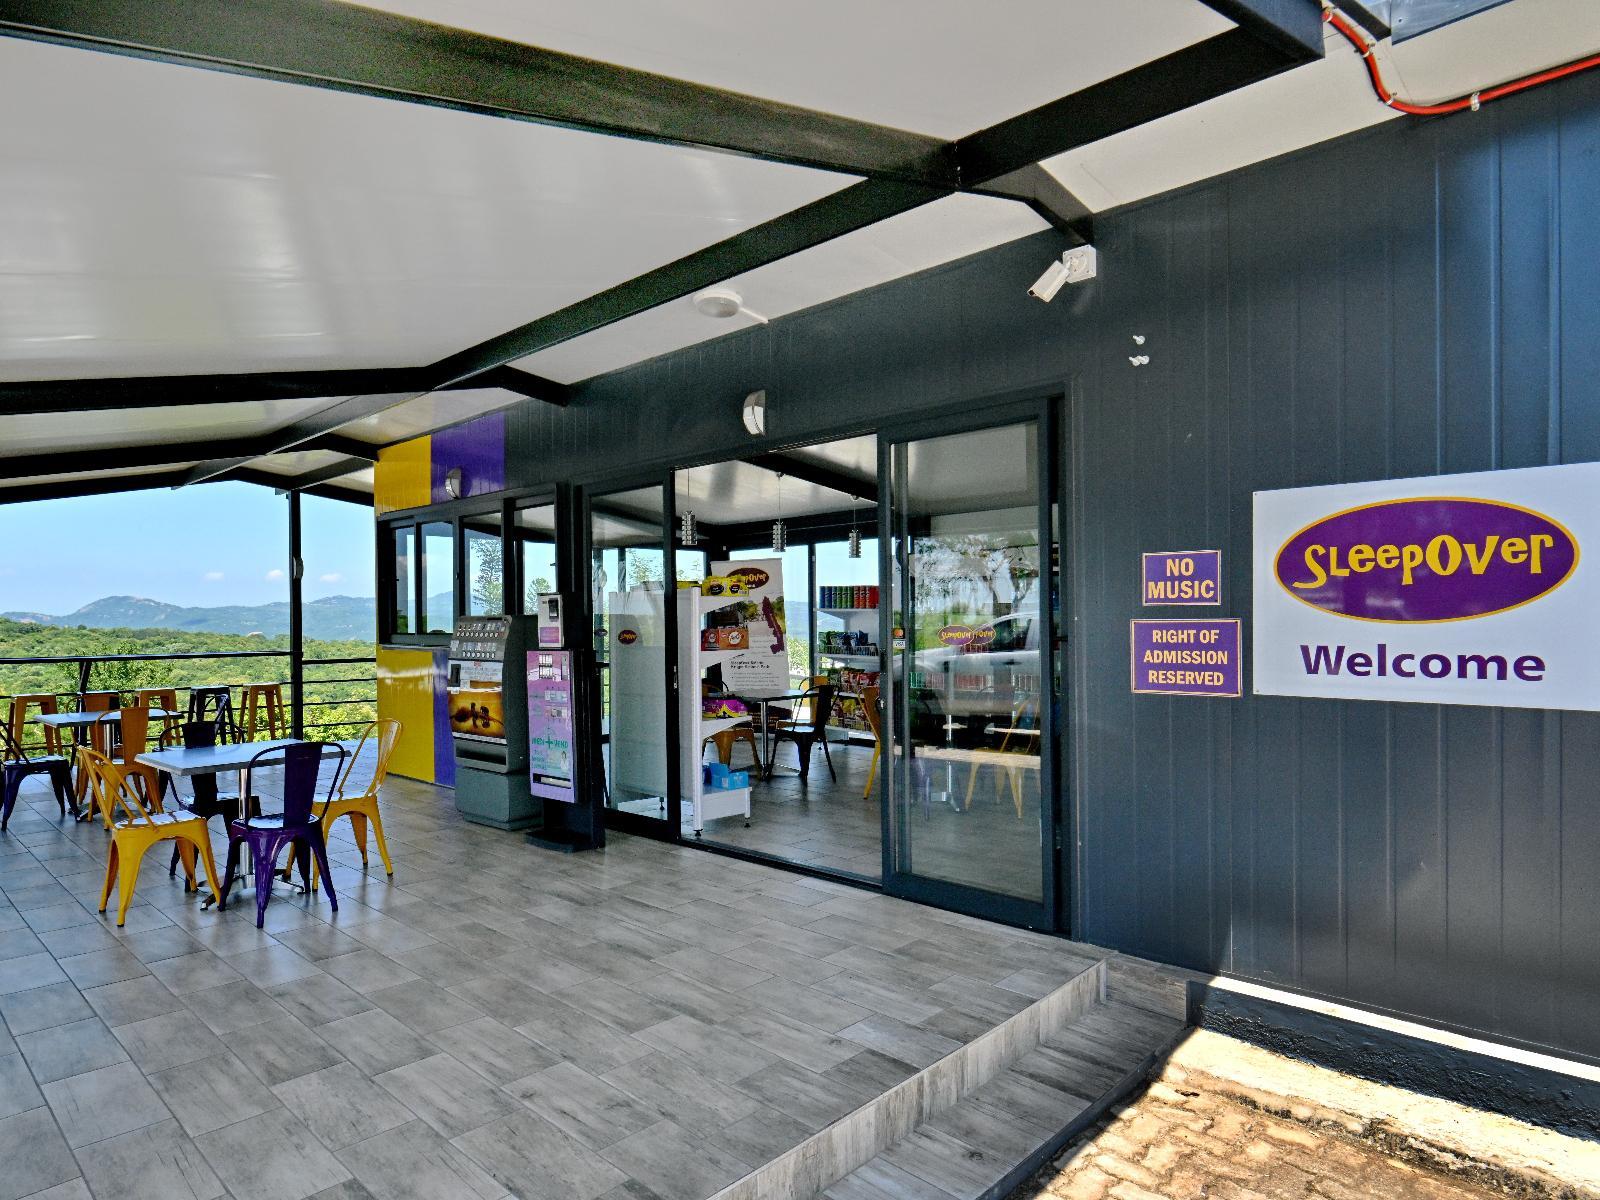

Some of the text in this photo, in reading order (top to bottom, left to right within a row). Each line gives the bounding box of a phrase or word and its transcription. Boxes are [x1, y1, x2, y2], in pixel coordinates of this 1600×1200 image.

[1166, 557, 1194, 577] NO
[1147, 579, 1215, 600] MUSIC
[1152, 629, 1220, 644] RIGHT OF
[1143, 649, 1228, 665] ADMISSION
[1300, 643, 1546, 682] Welcome
[1148, 669, 1224, 686] RESERVED
